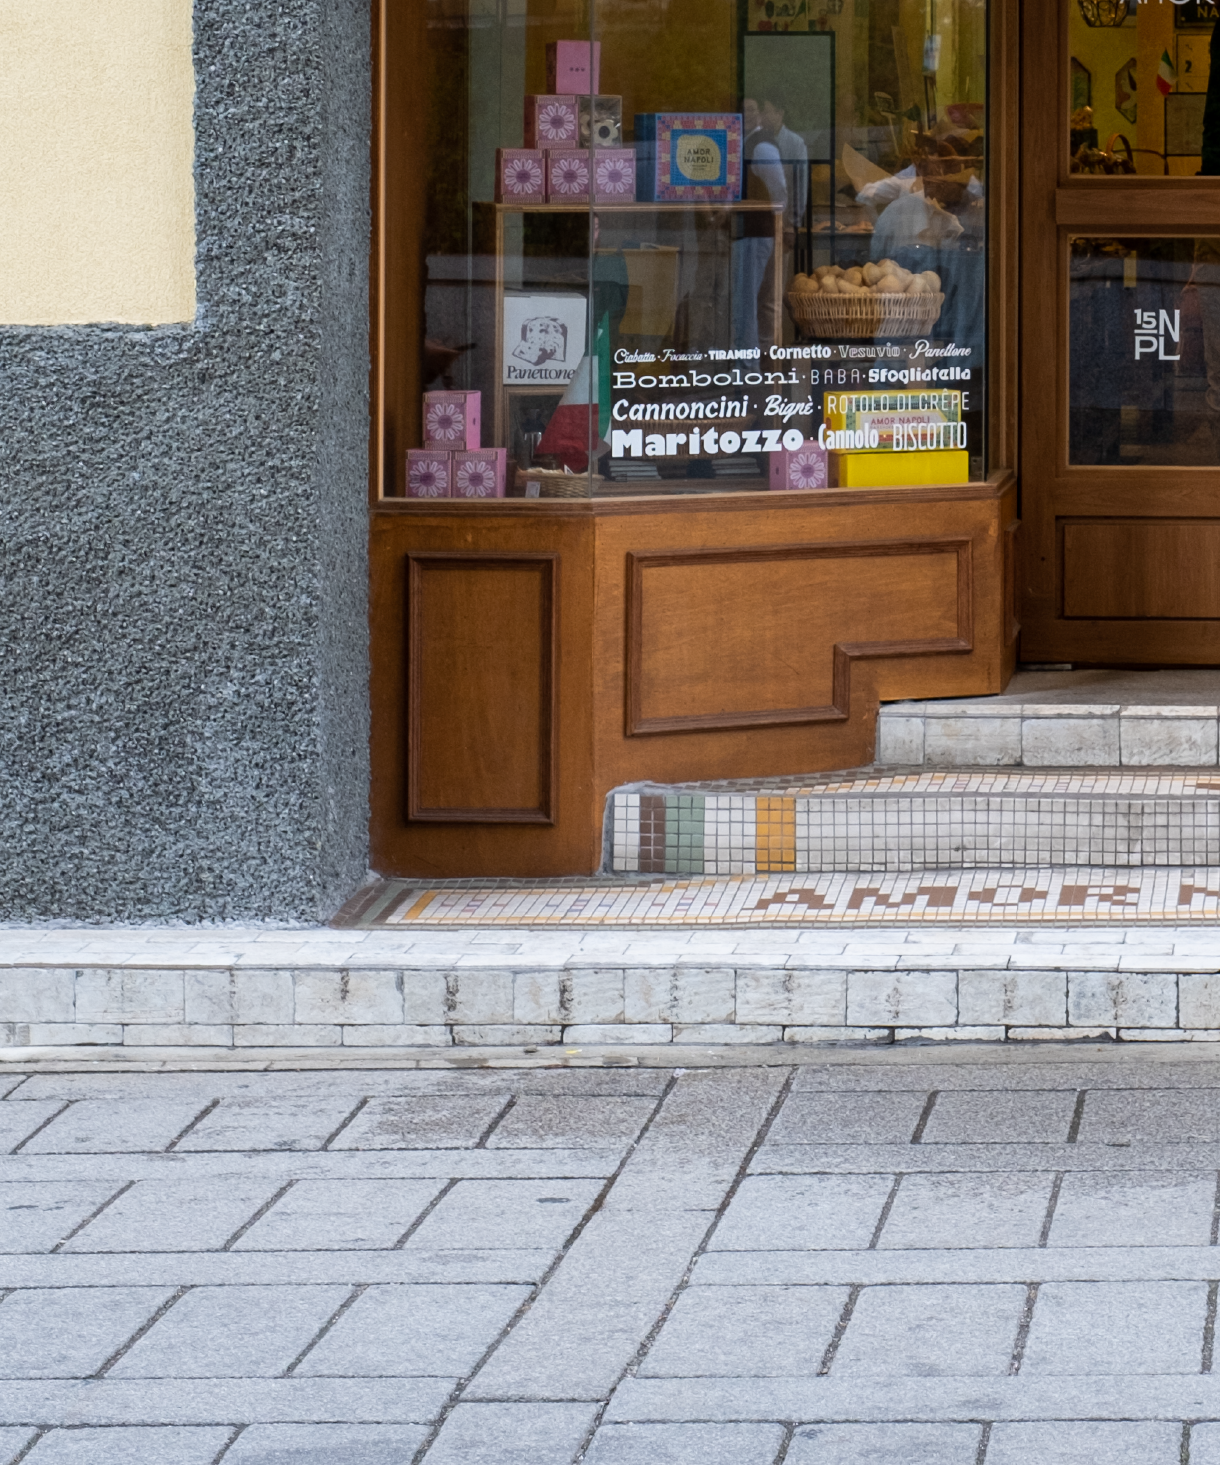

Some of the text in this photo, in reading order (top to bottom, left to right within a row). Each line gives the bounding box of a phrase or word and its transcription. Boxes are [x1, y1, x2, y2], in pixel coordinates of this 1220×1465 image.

[683, 156, 714, 164] NAPOLI
[613, 348, 656, 365] Ciabatta
[708, 346, 761, 361] TIRAMISÙ
[769, 344, 832, 360] Cornetto
[838, 343, 901, 359] Vesuvio
[909, 339, 972, 360] Panettone
[507, 365, 576, 380] Panettone
[612, 366, 972, 389] Bomboloni BABA Sfogliatella
[612, 388, 970, 424] Cannoncini Bignè ROTOLO DI CRÊPE
[870, 415, 930, 425] AMOR NAPOLI
[611, 422, 967, 458] Maritozzo Cannolo BISCOTTO
[753, 882, 1139, 912] AMOR
